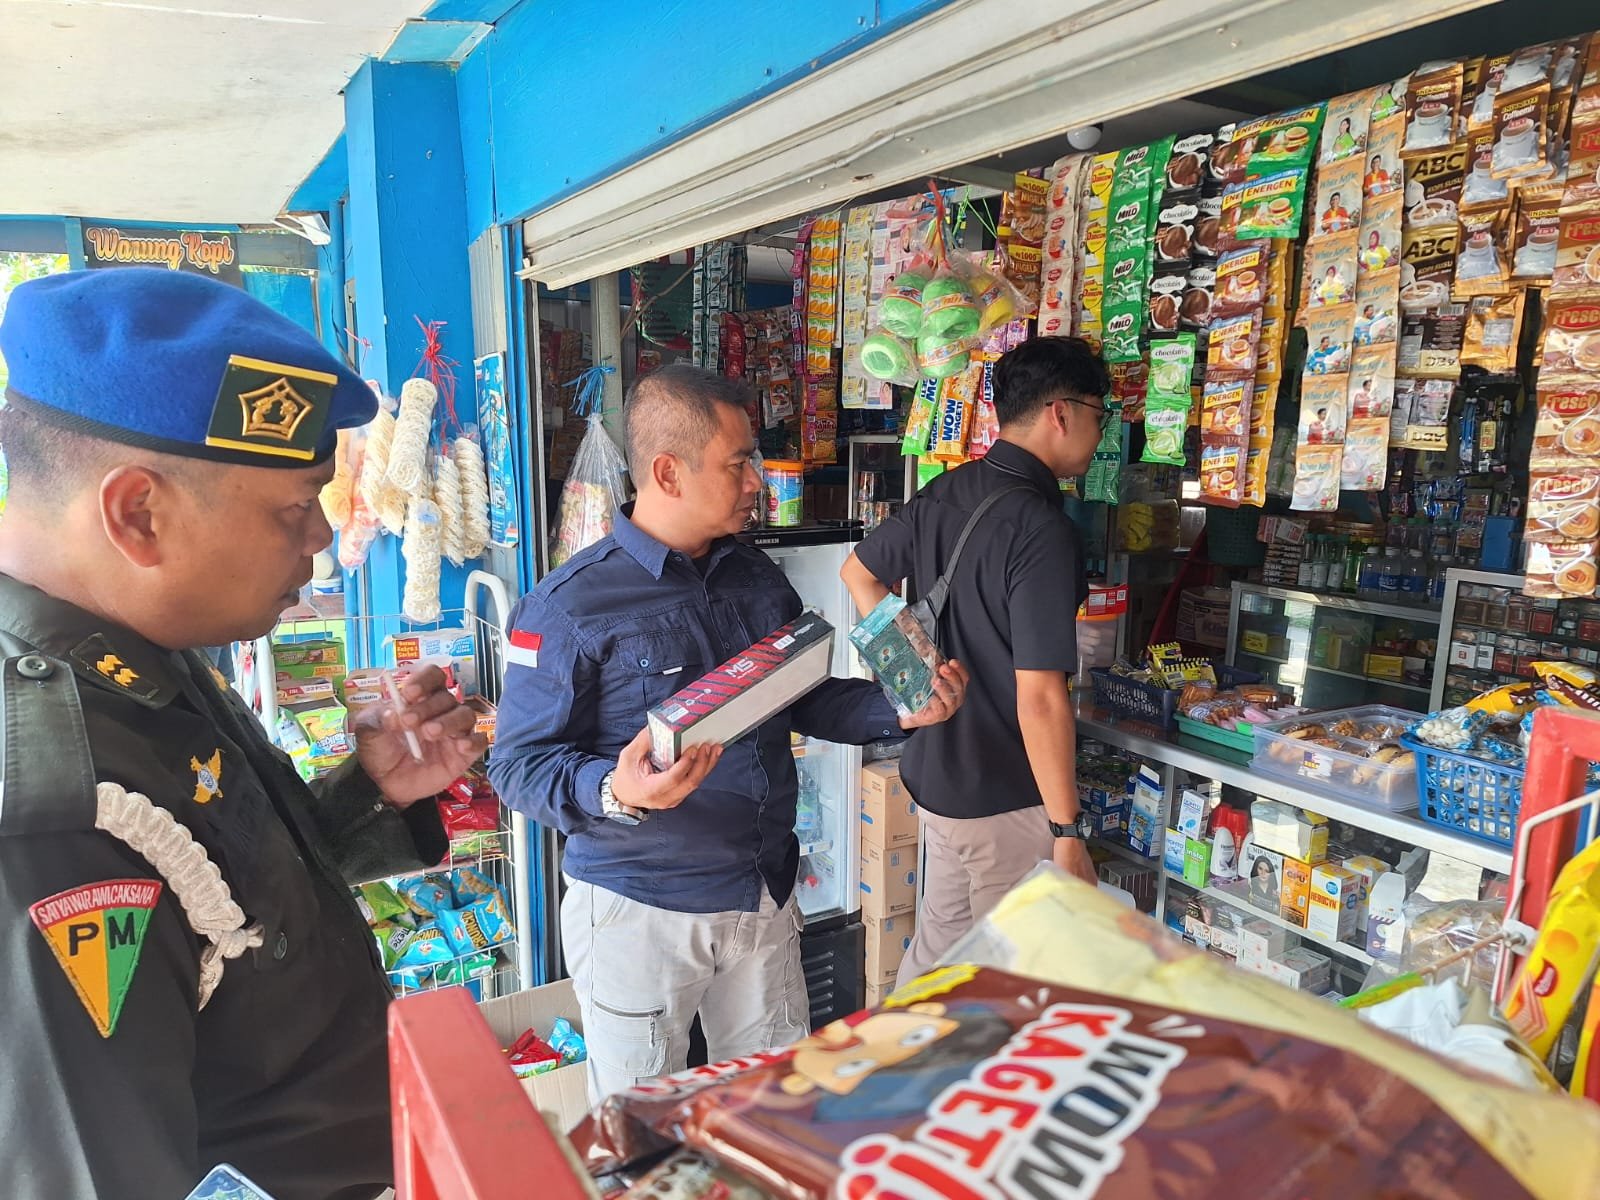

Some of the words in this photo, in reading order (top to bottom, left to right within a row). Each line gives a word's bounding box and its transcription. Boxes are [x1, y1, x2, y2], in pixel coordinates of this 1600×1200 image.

[1125, 150, 1145, 164] MILO
[1410, 152, 1464, 178] ABC
[1246, 180, 1292, 197] ENERGEN
[1118, 207, 1137, 220] MILO
[87, 227, 183, 271] Warung
[182, 232, 235, 274] Kopi
[1402, 236, 1454, 259] ABC
[1114, 262, 1132, 276] MILO
[1219, 254, 1256, 272] ENERGEN
[1110, 318, 1131, 330] MILO
[1212, 323, 1249, 339] ENERGEN
[1207, 391, 1240, 404] ENERGEN
[1544, 393, 1598, 410] Fresco
[942, 399, 956, 441] WOW
[954, 401, 963, 440] SPAGETI
[1104, 813, 1118, 823] ABC
[68, 921, 100, 957] P
[106, 911, 136, 950] M
[929, 1010, 1120, 1169] KAGET
[1010, 1040, 1168, 1200] WOW
